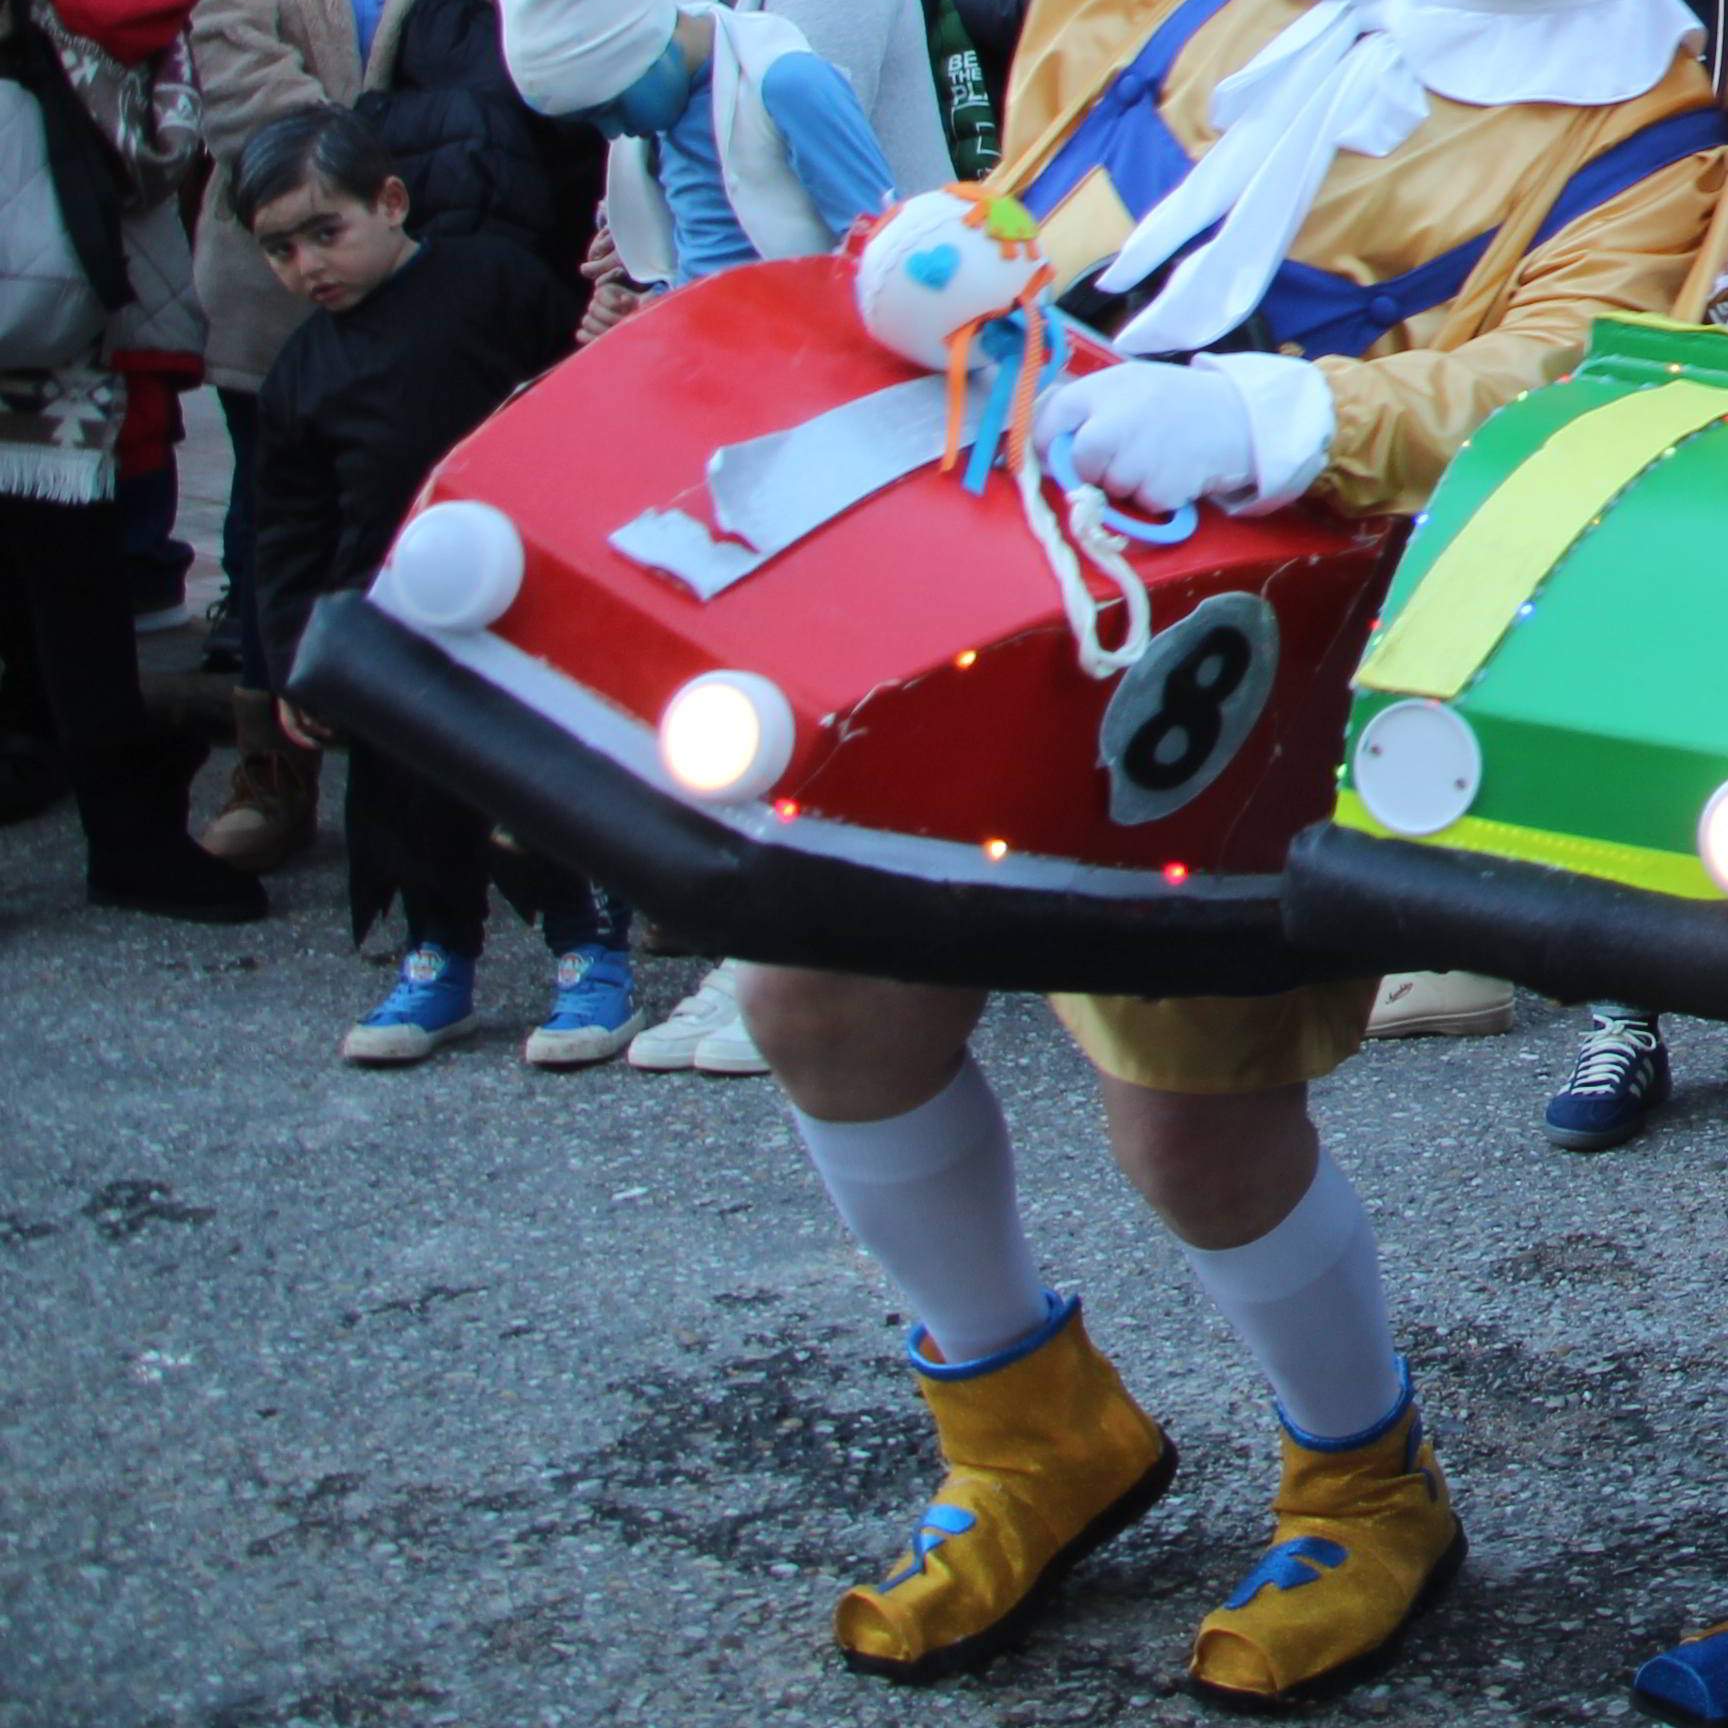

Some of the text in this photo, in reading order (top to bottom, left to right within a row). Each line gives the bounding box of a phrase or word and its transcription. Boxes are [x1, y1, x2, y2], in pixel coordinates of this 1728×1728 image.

[948, 50, 978, 72] BE
[950, 68, 982, 83] THE
[1123, 626, 1250, 791] 8
